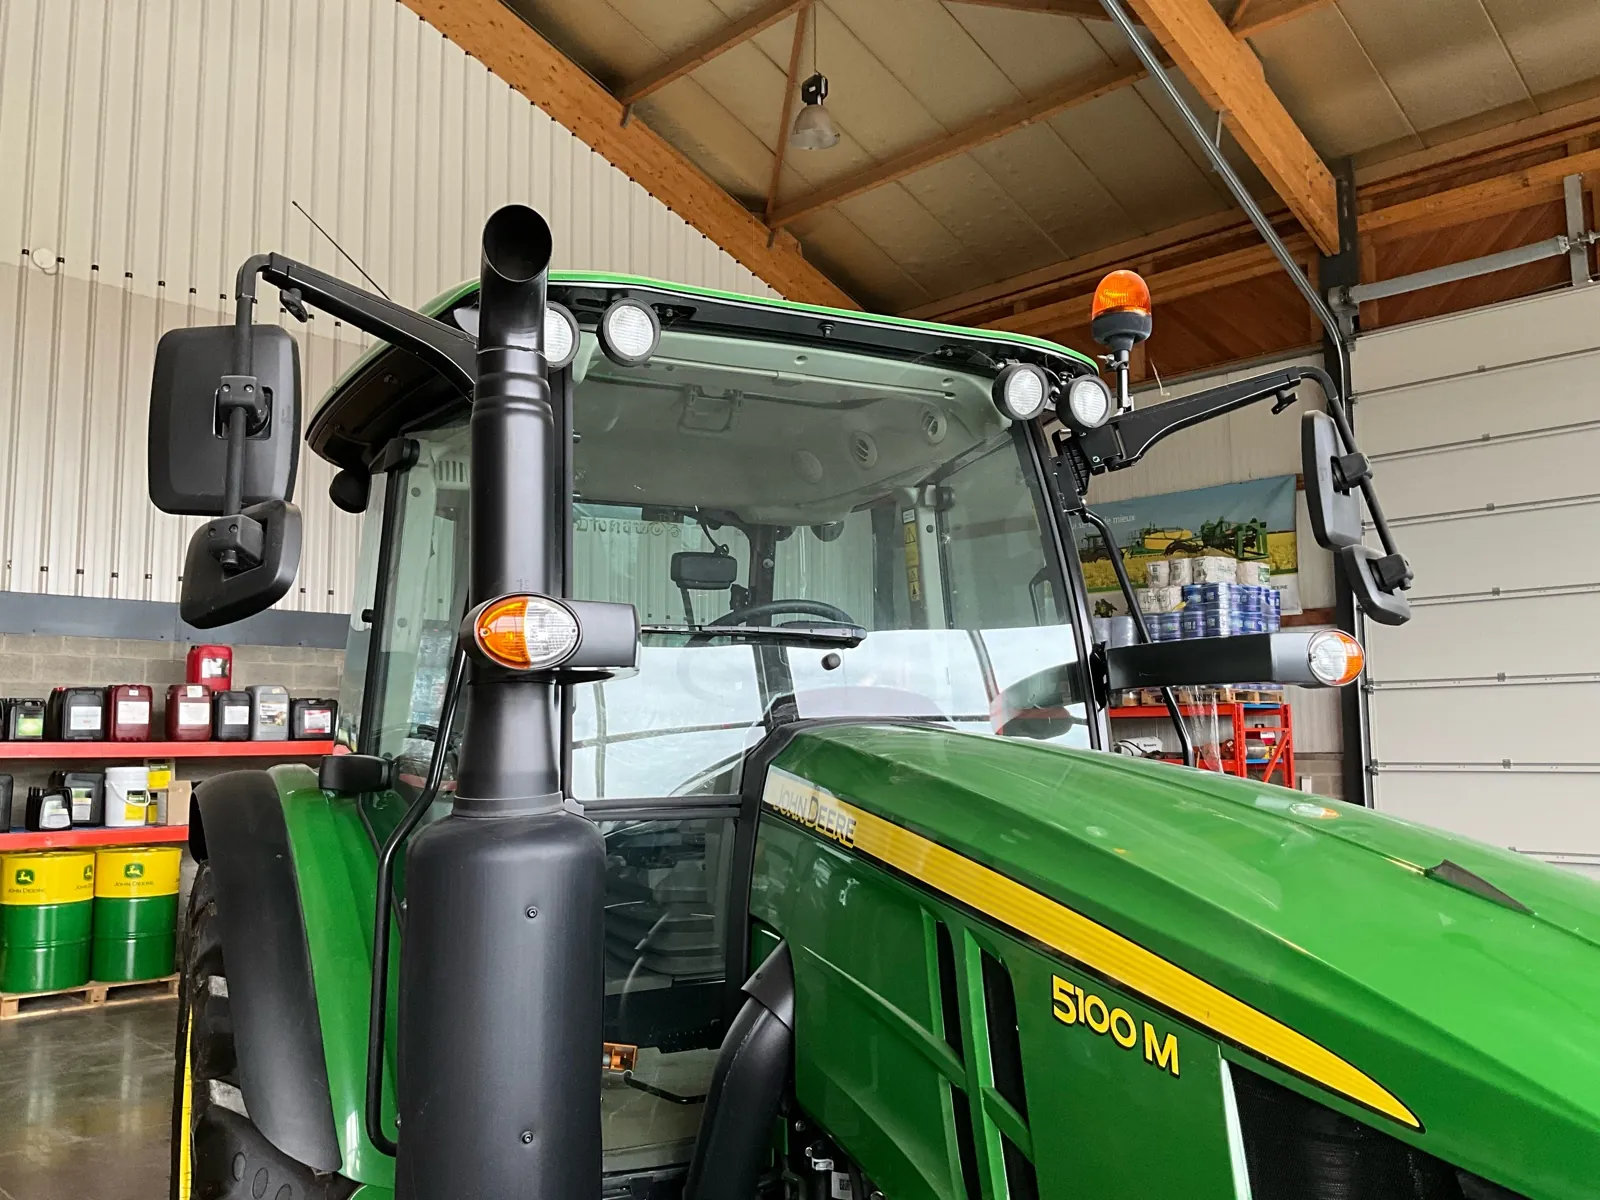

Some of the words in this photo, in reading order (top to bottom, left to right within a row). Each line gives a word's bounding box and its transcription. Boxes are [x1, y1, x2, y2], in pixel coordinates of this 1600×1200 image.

[772, 784, 808, 824] JOHN
[806, 795, 857, 849] DEERE
[1051, 973, 1138, 1050] 5100
[1143, 1019, 1180, 1079] M
